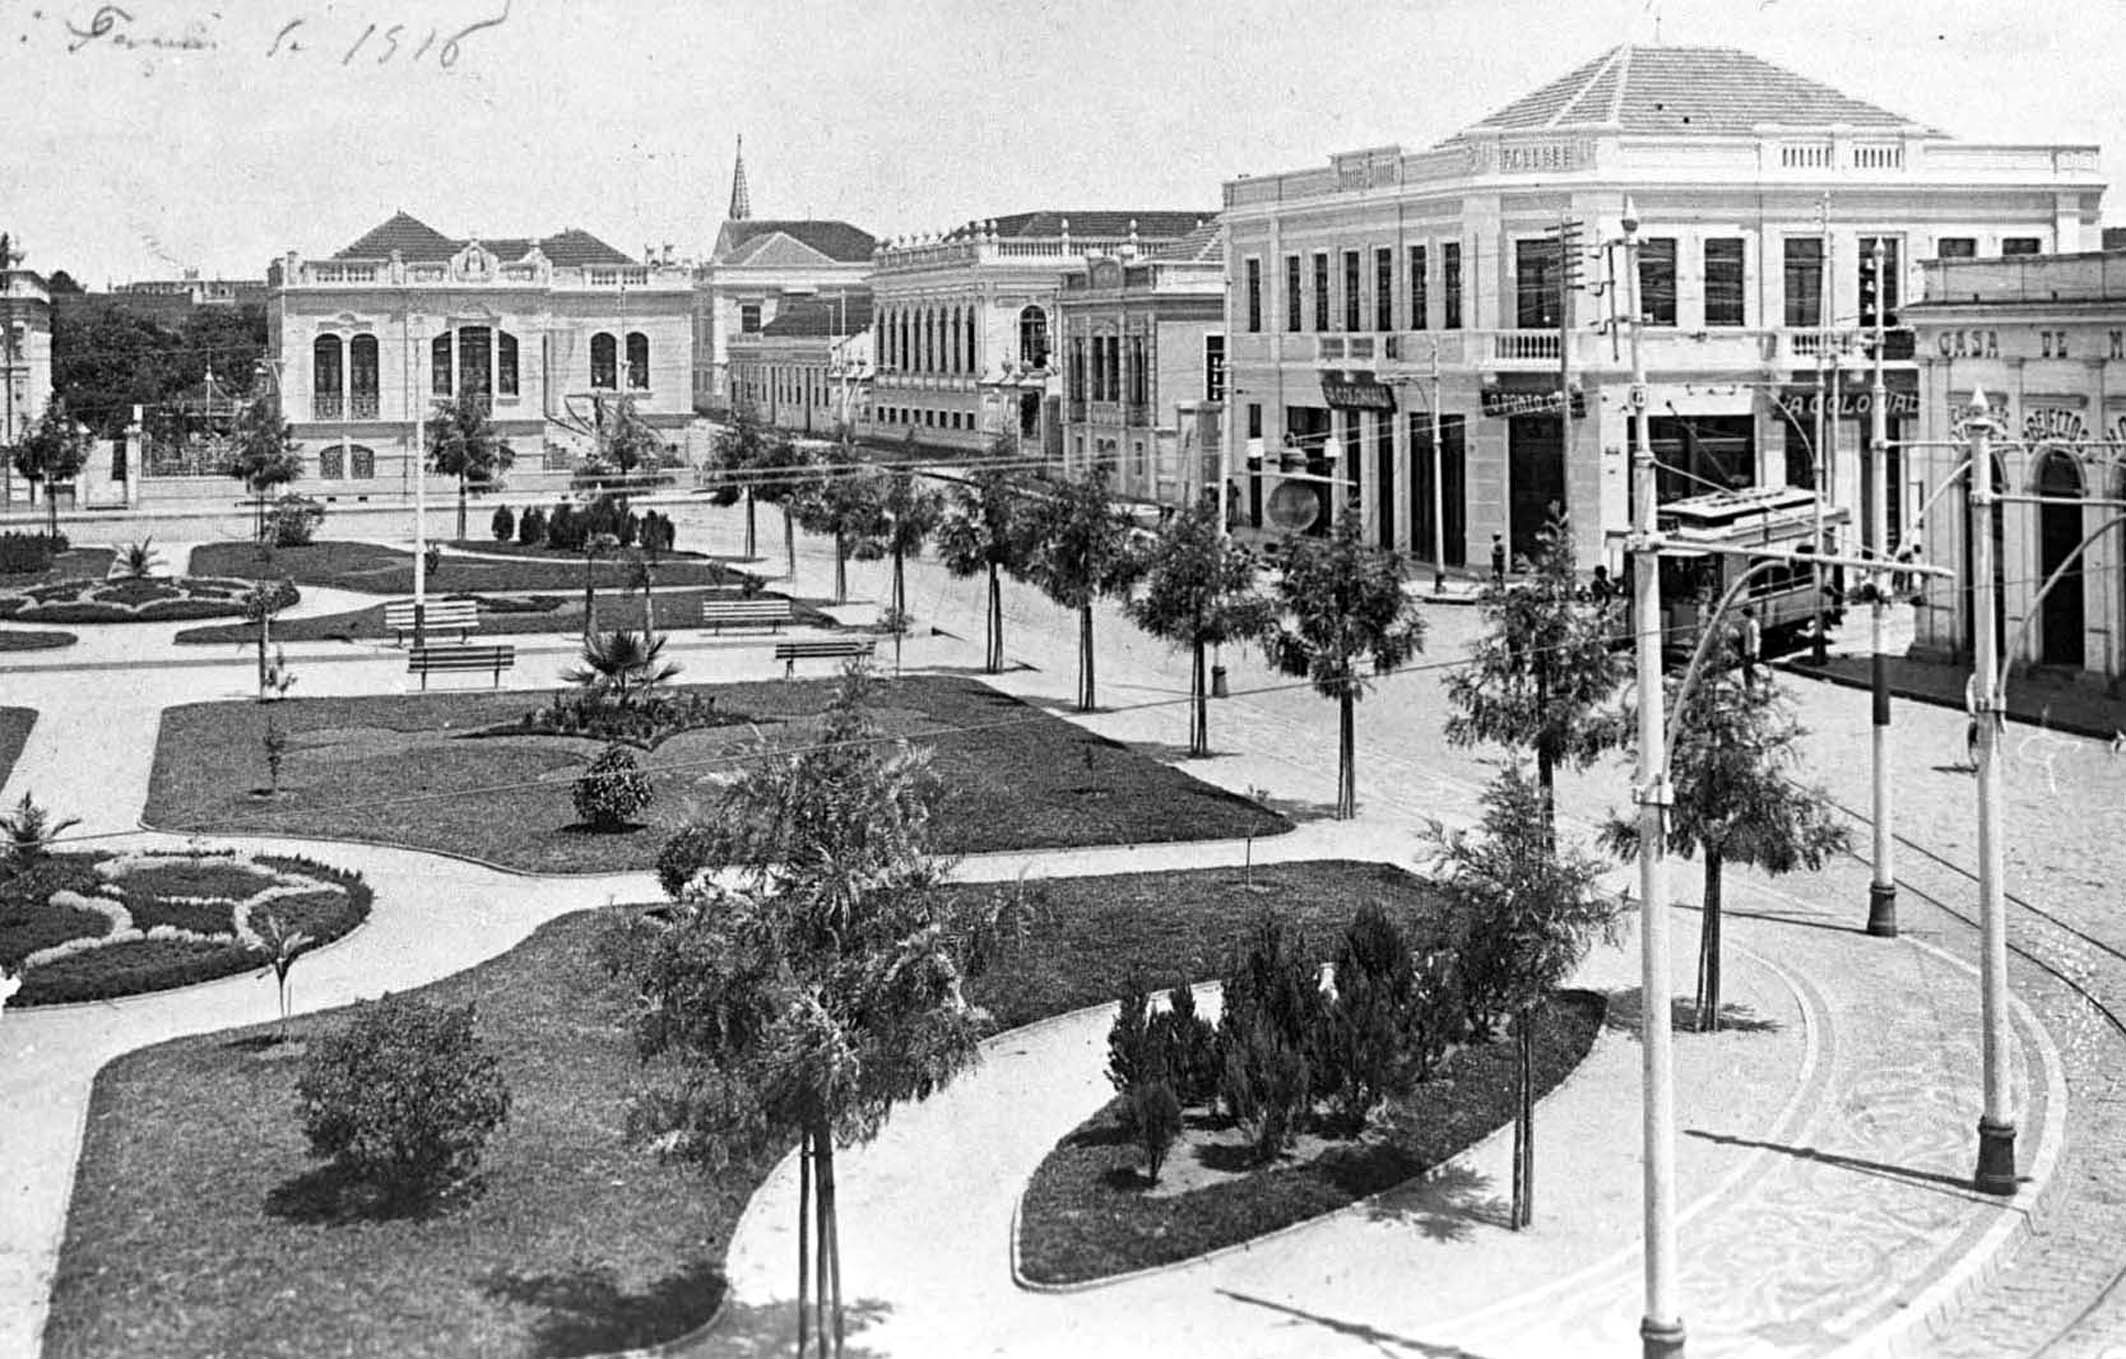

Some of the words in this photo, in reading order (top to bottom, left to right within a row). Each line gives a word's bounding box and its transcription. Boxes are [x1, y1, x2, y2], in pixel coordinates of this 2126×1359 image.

[1939, 329, 1998, 359] CASA
[2041, 330, 2068, 359] DE
[1809, 393, 1921, 415] COLOIAL
